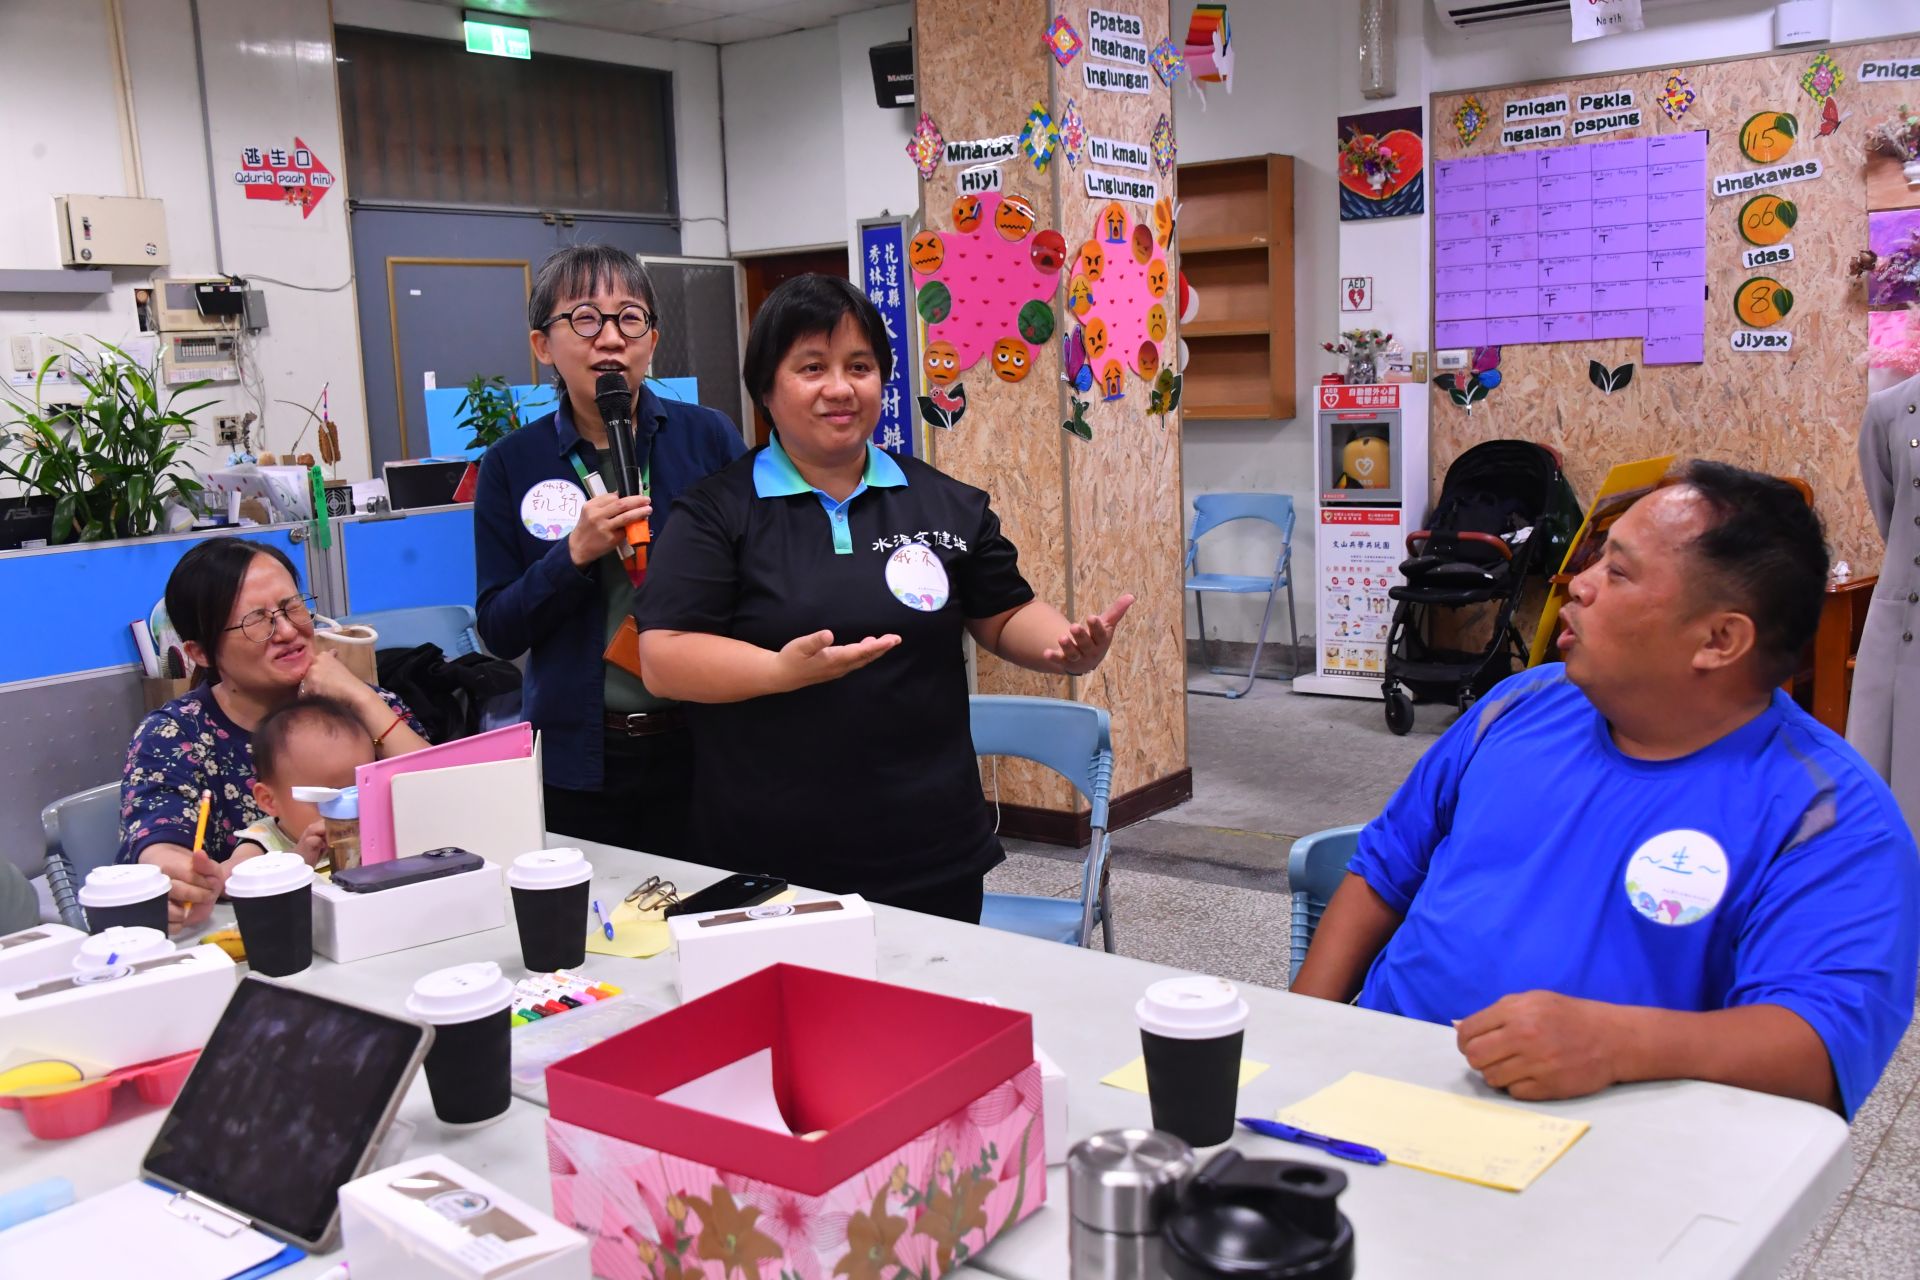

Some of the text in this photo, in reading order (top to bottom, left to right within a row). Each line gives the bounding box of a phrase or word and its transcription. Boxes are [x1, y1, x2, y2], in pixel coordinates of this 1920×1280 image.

[1090, 11, 1141, 35] Ppatas
[1091, 37, 1146, 65] ngahang
[1506, 93, 1632, 118] Pniqan Pgkla
[1503, 112, 1640, 142] ngalan pspung
[1746, 127, 1776, 151] 115
[244, 147, 310, 166] 逃生口
[947, 143, 1014, 162] Mnarux
[1091, 140, 1148, 166] Ini kmalu
[278, 175, 305, 184] paah
[312, 176, 331, 185] hini
[961, 171, 999, 192] Hiyi
[1087, 174, 1155, 199] Lnglungan
[1716, 162, 1818, 194] Hngkawas
[1747, 201, 1775, 229] 06
[868, 243, 885, 309] 秀林鄉
[885, 242, 902, 309] 花蓮縣
[1347, 279, 1366, 289] AED
[1750, 286, 1771, 314] 8
[1733, 333, 1788, 348] Jiyax
